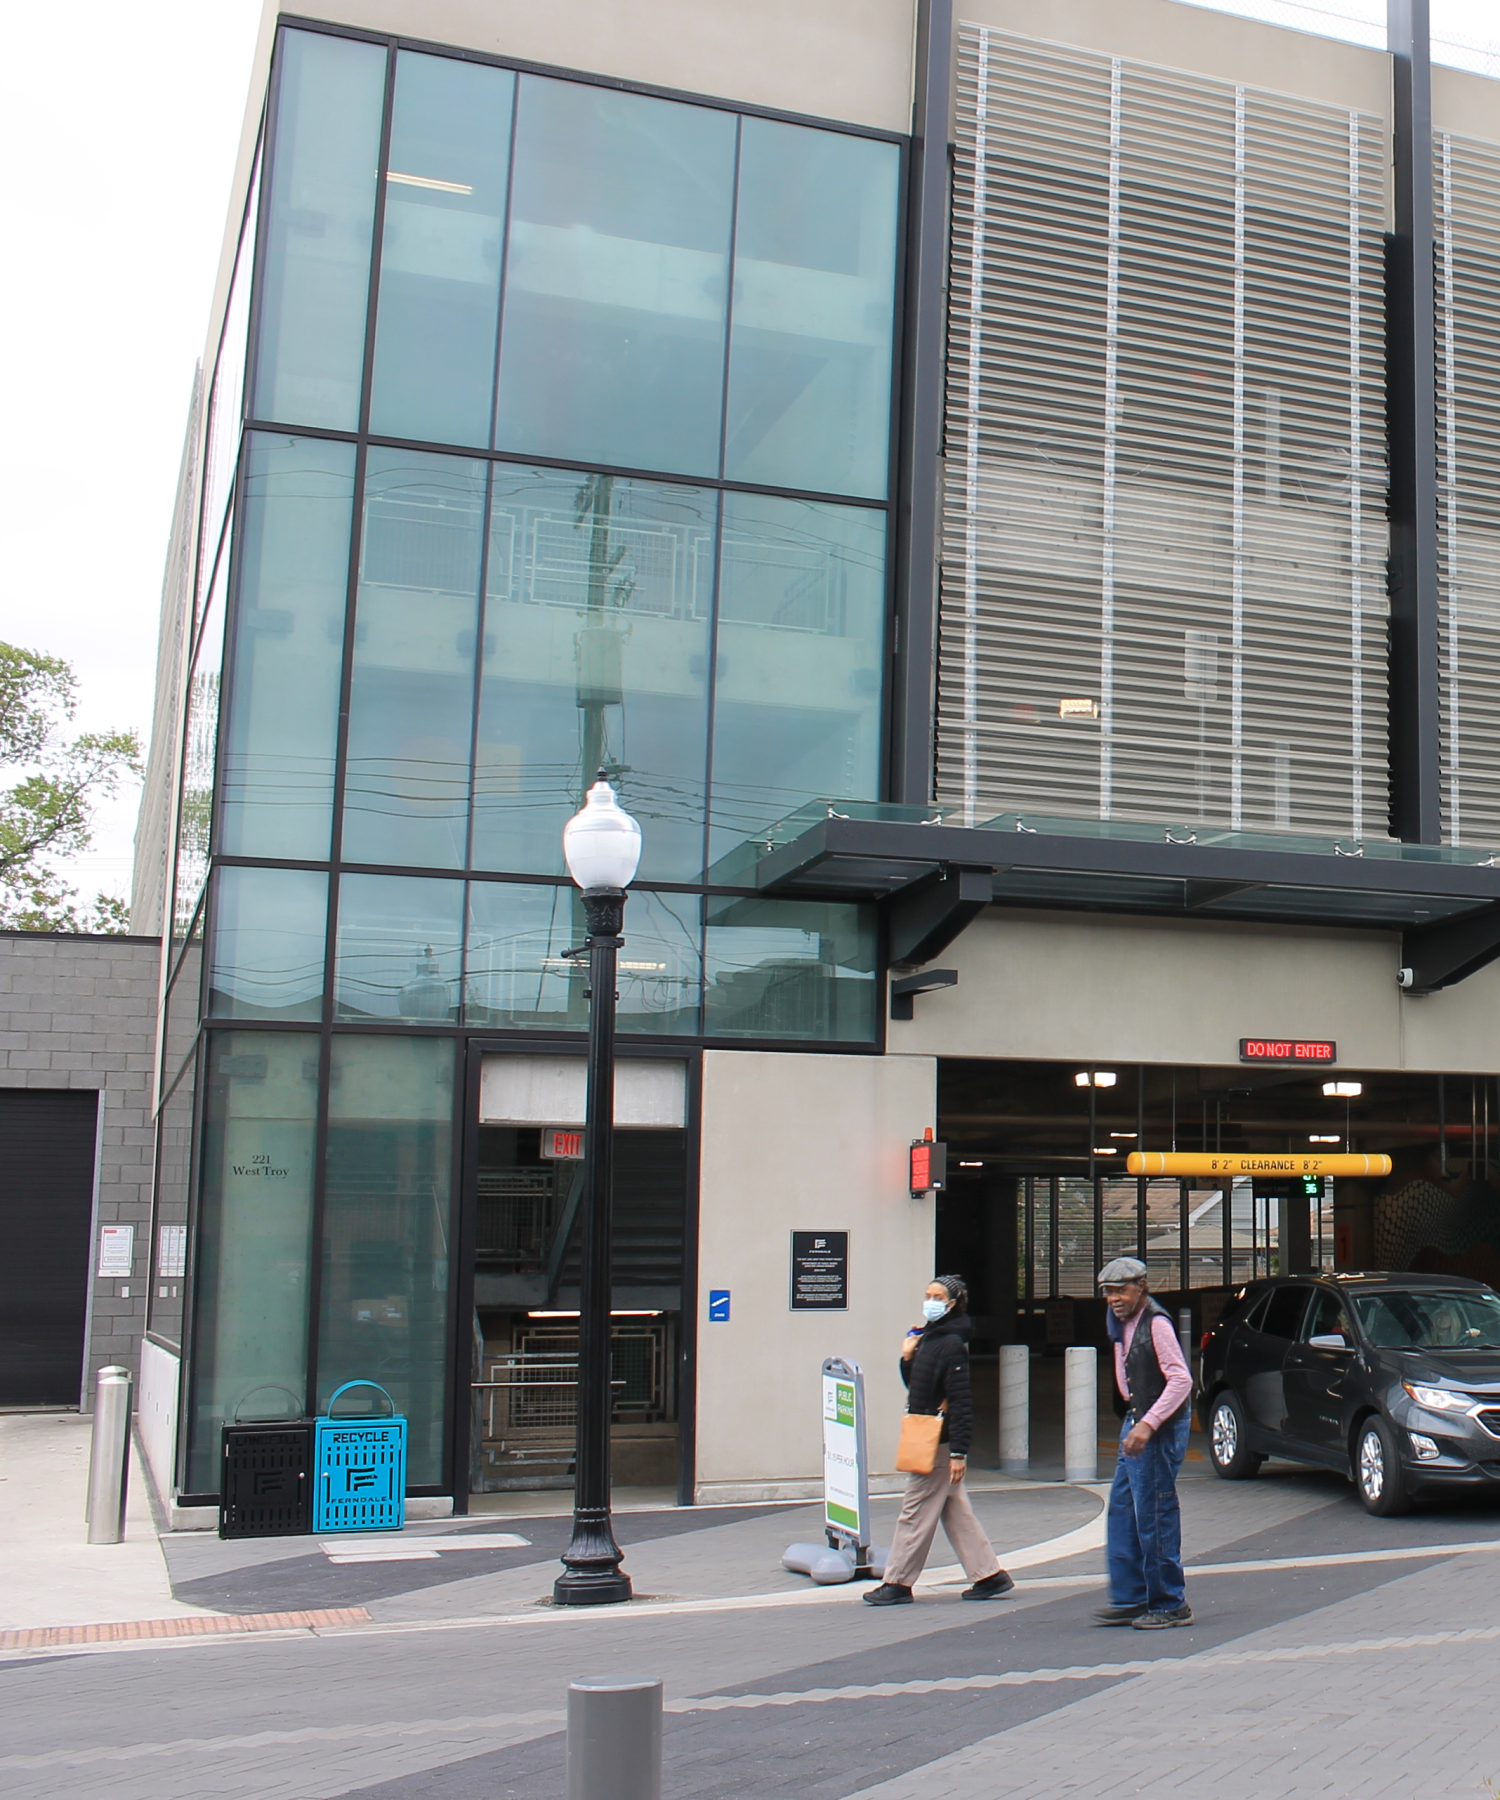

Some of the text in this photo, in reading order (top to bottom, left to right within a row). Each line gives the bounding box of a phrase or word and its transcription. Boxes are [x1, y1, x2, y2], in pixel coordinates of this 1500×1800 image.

[1247, 1042, 1331, 1058] DO NOT ENTER
[554, 1133, 582, 1155] EXIT
[252, 1155, 271, 1164] 221
[1211, 1160, 1220, 1170] 8'
[1240, 1160, 1296, 1170] CLEARANCE
[233, 1166, 289, 1179] West Troy
[1305, 1183, 1317, 1194] 36
[838, 1389, 852, 1402] PUBLIC
[837, 1403, 854, 1417] PARKING
[333, 1431, 389, 1443] RECYCLE
